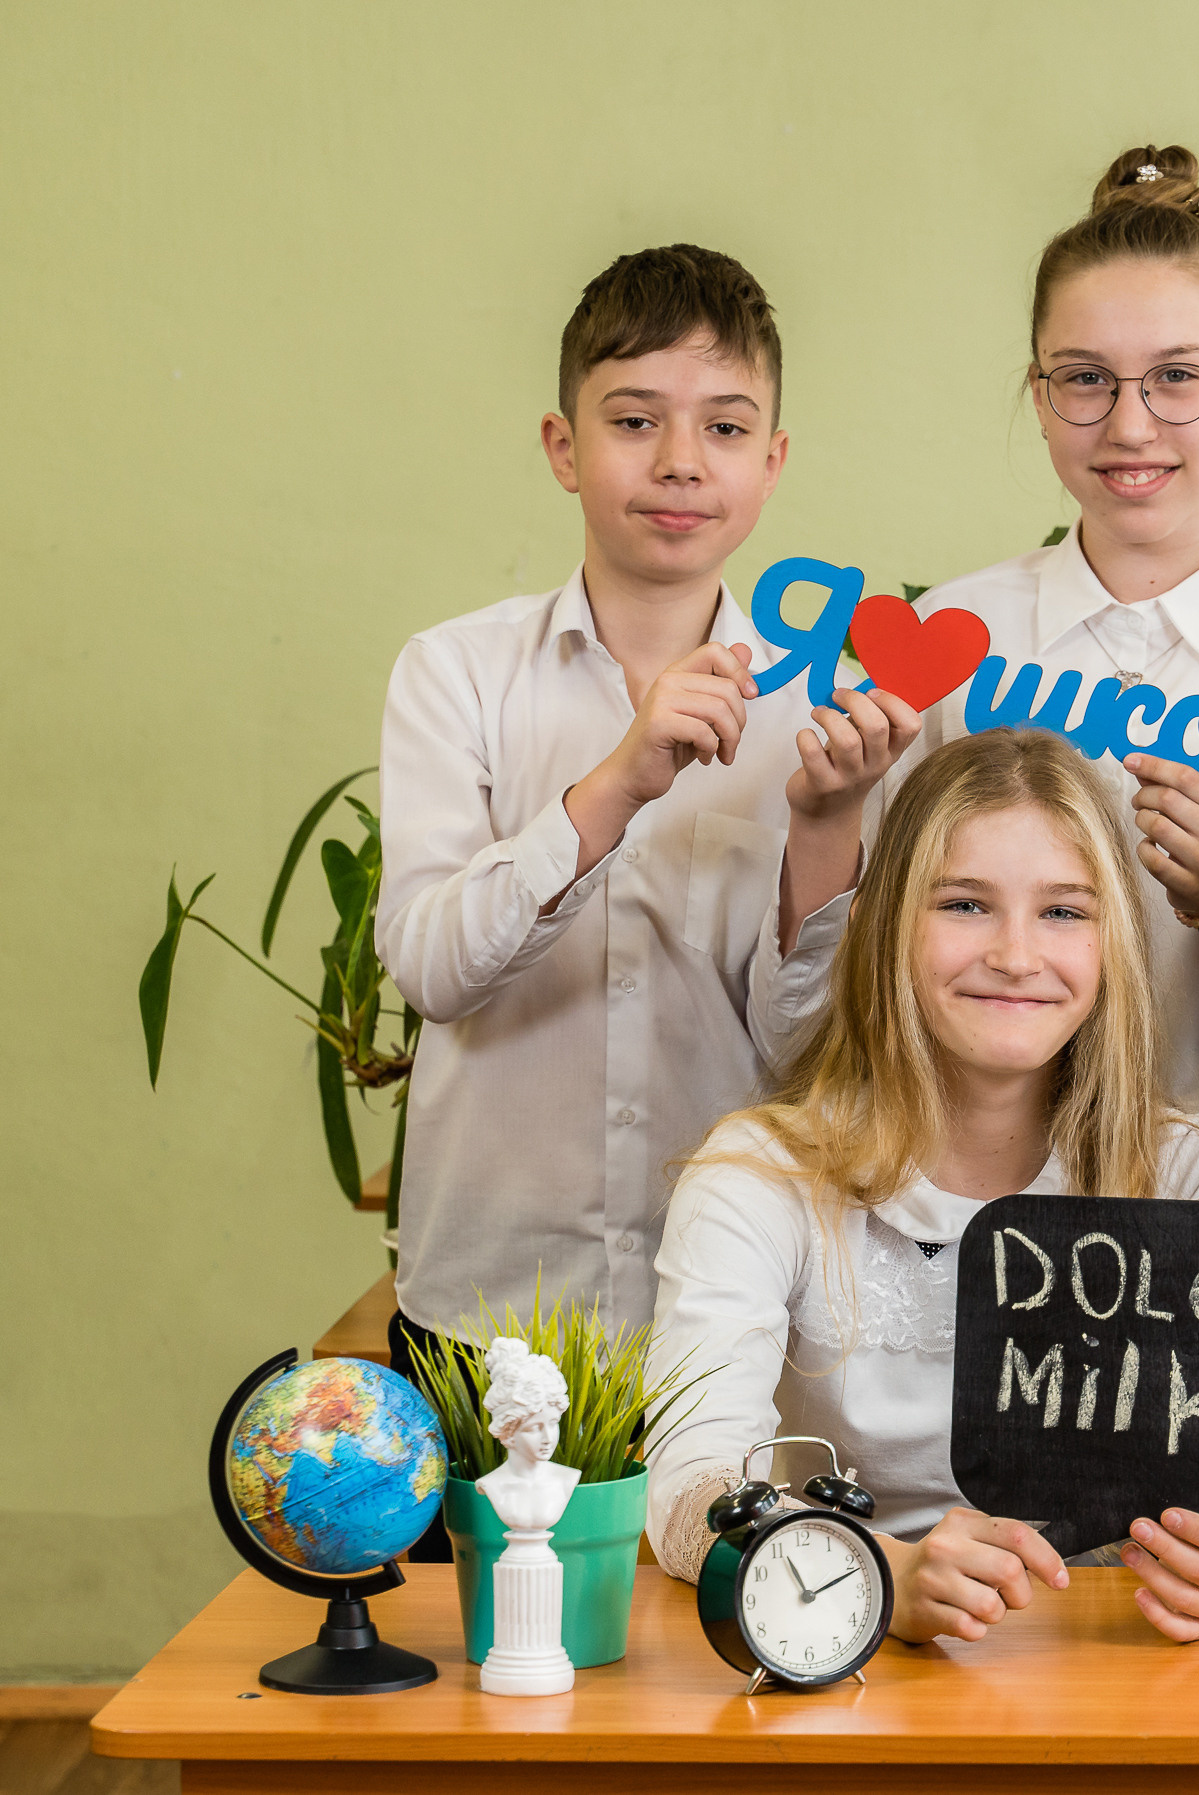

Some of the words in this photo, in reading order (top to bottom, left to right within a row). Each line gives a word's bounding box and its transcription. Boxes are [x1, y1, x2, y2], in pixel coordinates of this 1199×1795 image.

[750, 556, 877, 715] Я
[795, 1530, 810, 1546] 12
[772, 1543, 783, 1558] 11
[846, 1555, 855, 1570] 2
[755, 1566, 767, 1582] 10
[856, 1584, 865, 1598] 3
[746, 1594, 755, 1609] 9
[848, 1612, 857, 1626] 4
[757, 1623, 766, 1637] 8
[779, 1640, 788, 1655] 7
[832, 1637, 841, 1651] 5
[805, 1647, 814, 1661] 6
